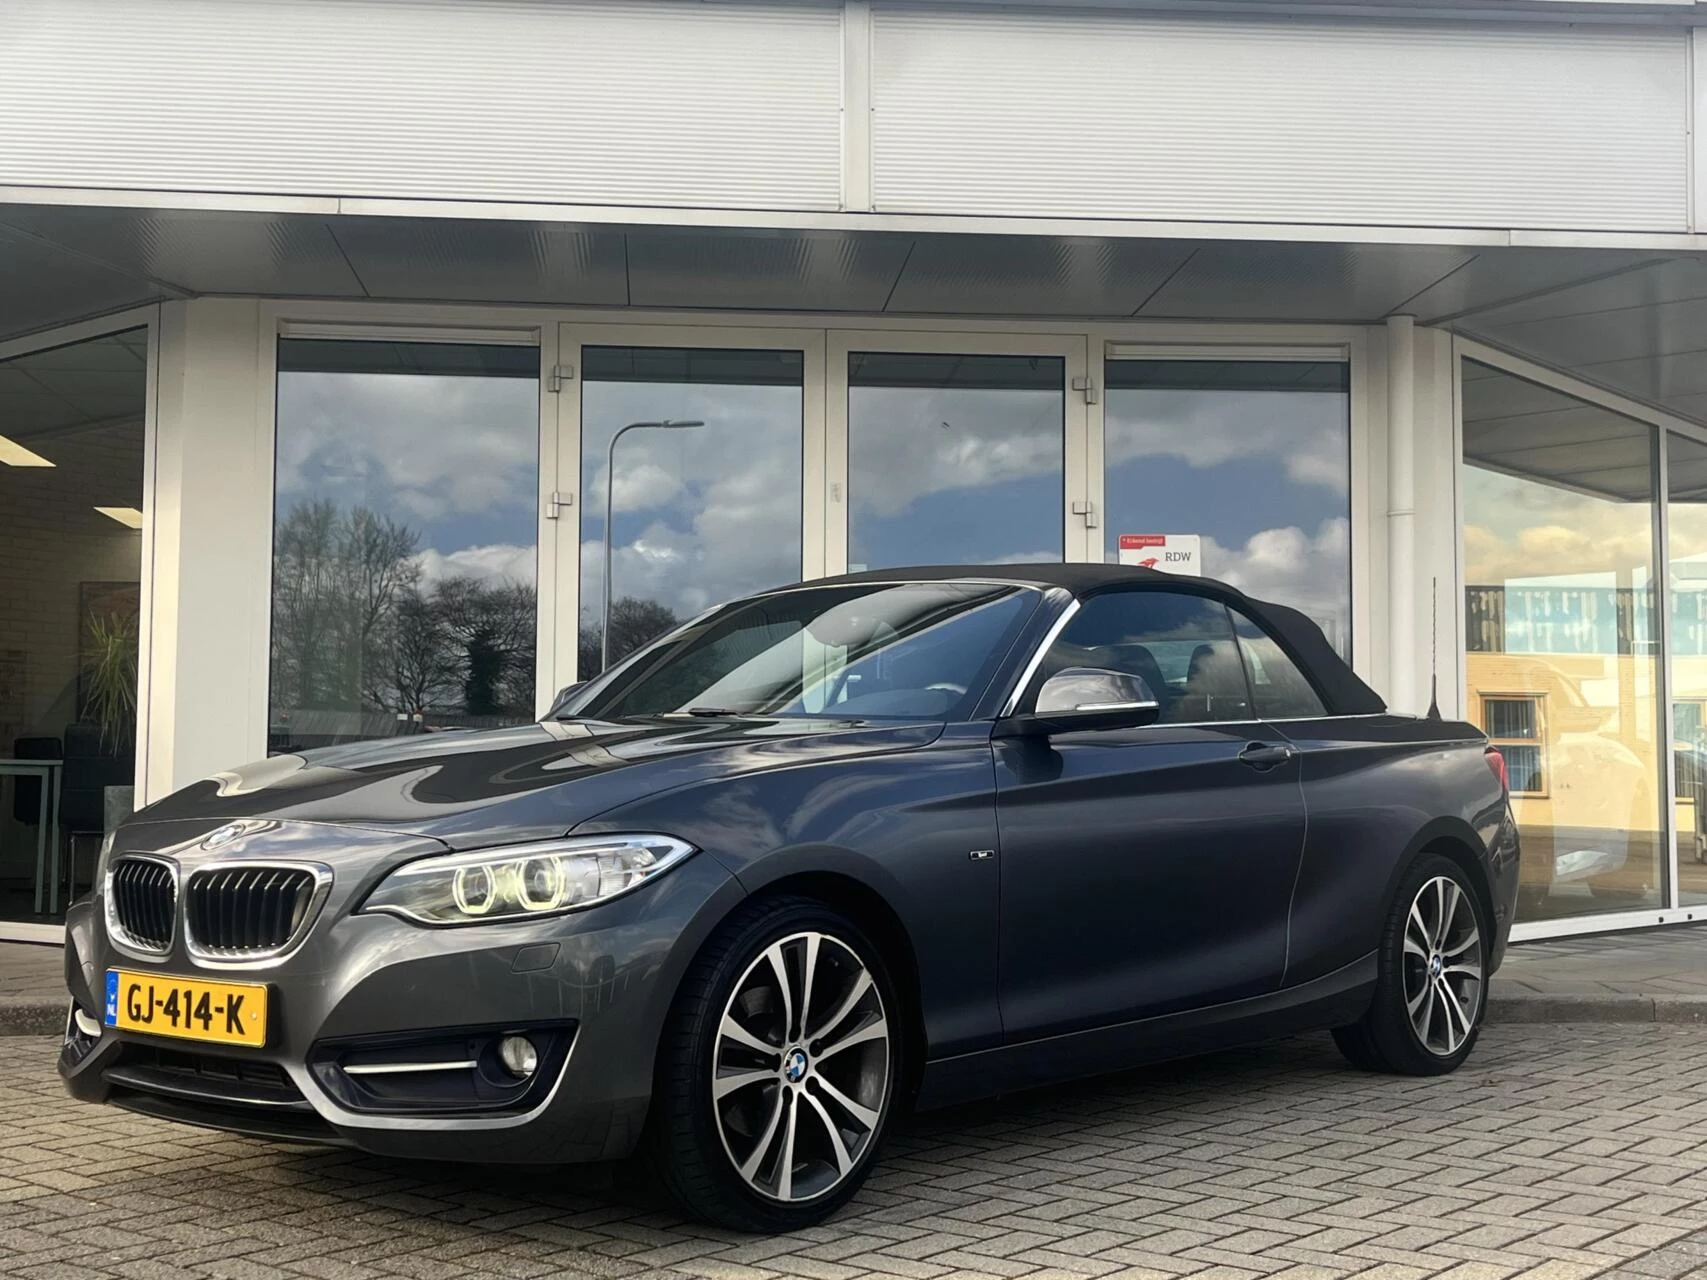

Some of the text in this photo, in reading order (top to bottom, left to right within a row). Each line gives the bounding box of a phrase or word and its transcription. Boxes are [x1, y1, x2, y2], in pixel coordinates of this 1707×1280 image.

[1165, 552, 1192, 562] RDW
[106, 1004, 116, 1016] NL
[127, 983, 246, 1036] GJ-414-K
